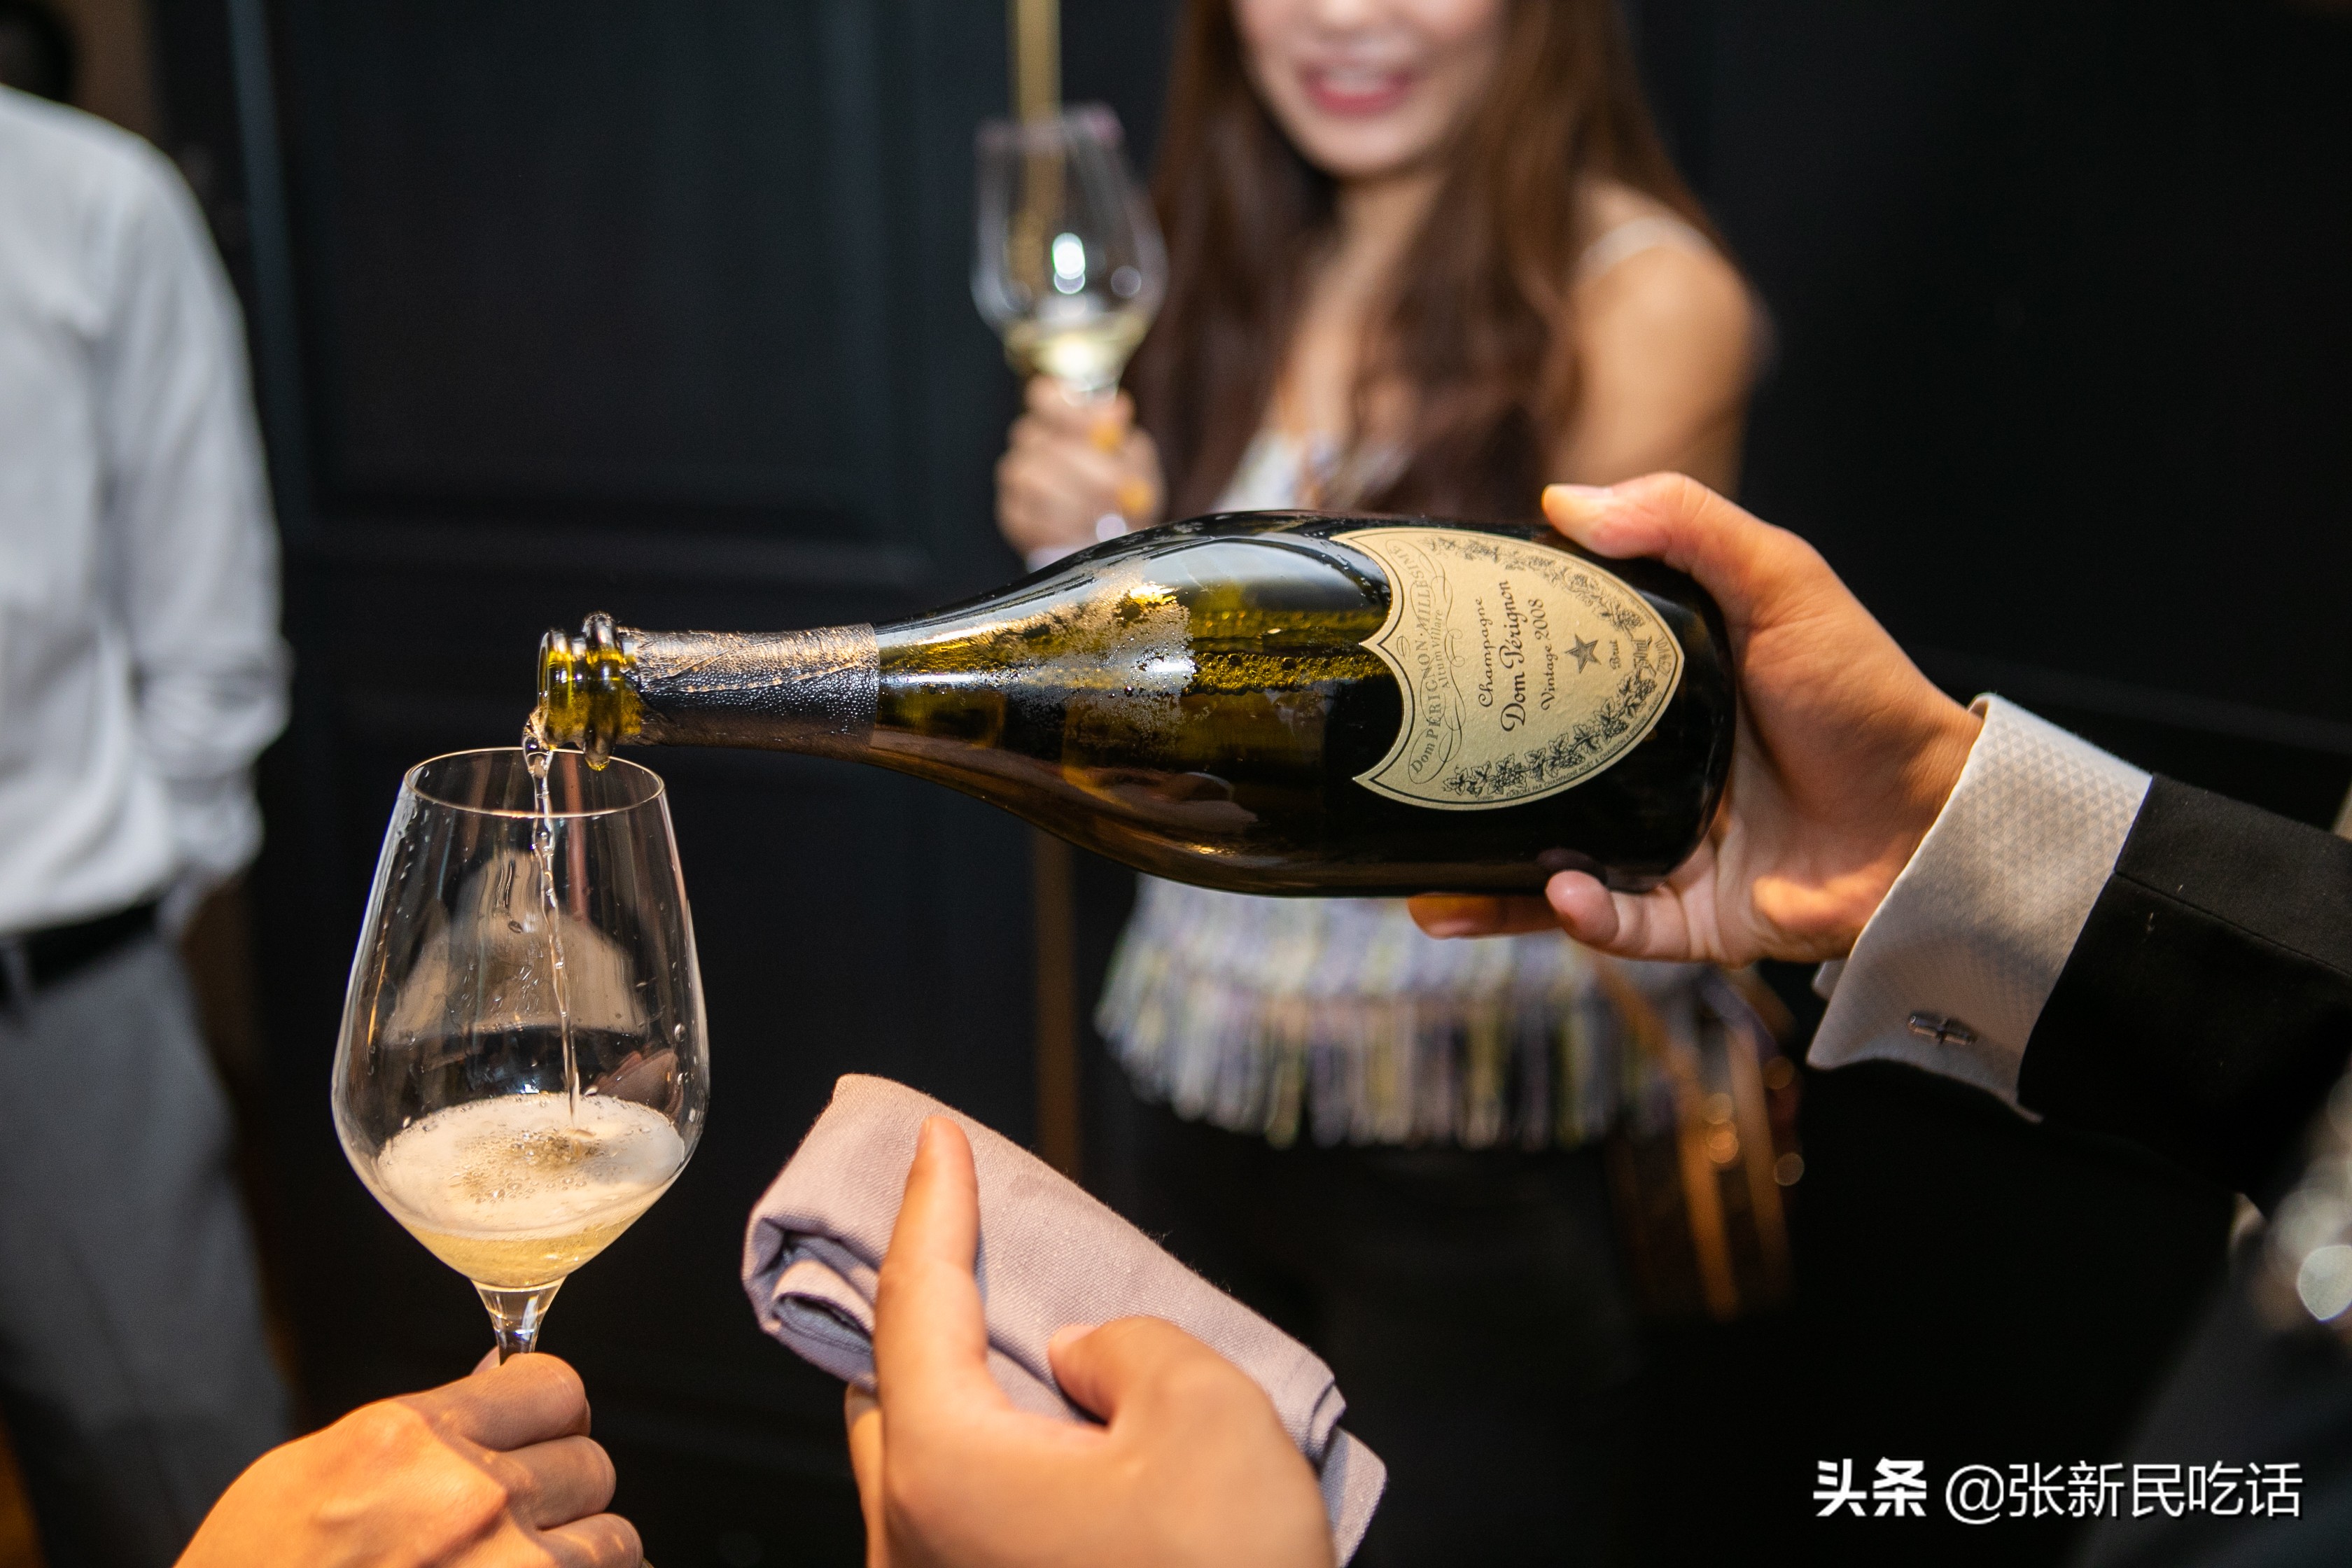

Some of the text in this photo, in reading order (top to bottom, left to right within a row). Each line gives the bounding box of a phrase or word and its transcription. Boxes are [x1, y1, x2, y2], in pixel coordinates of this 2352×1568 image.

[1434, 650, 1450, 689] Altum
[1475, 596, 1497, 708] Champagne
[1499, 580, 1529, 732] Dom Pérignon
[1528, 598, 1559, 711] Vintage 2008
[1609, 639, 1622, 671] Brut
[1410, 742, 1435, 774] Dom
[1544, 769, 1578, 788] CHAMPAGNE
